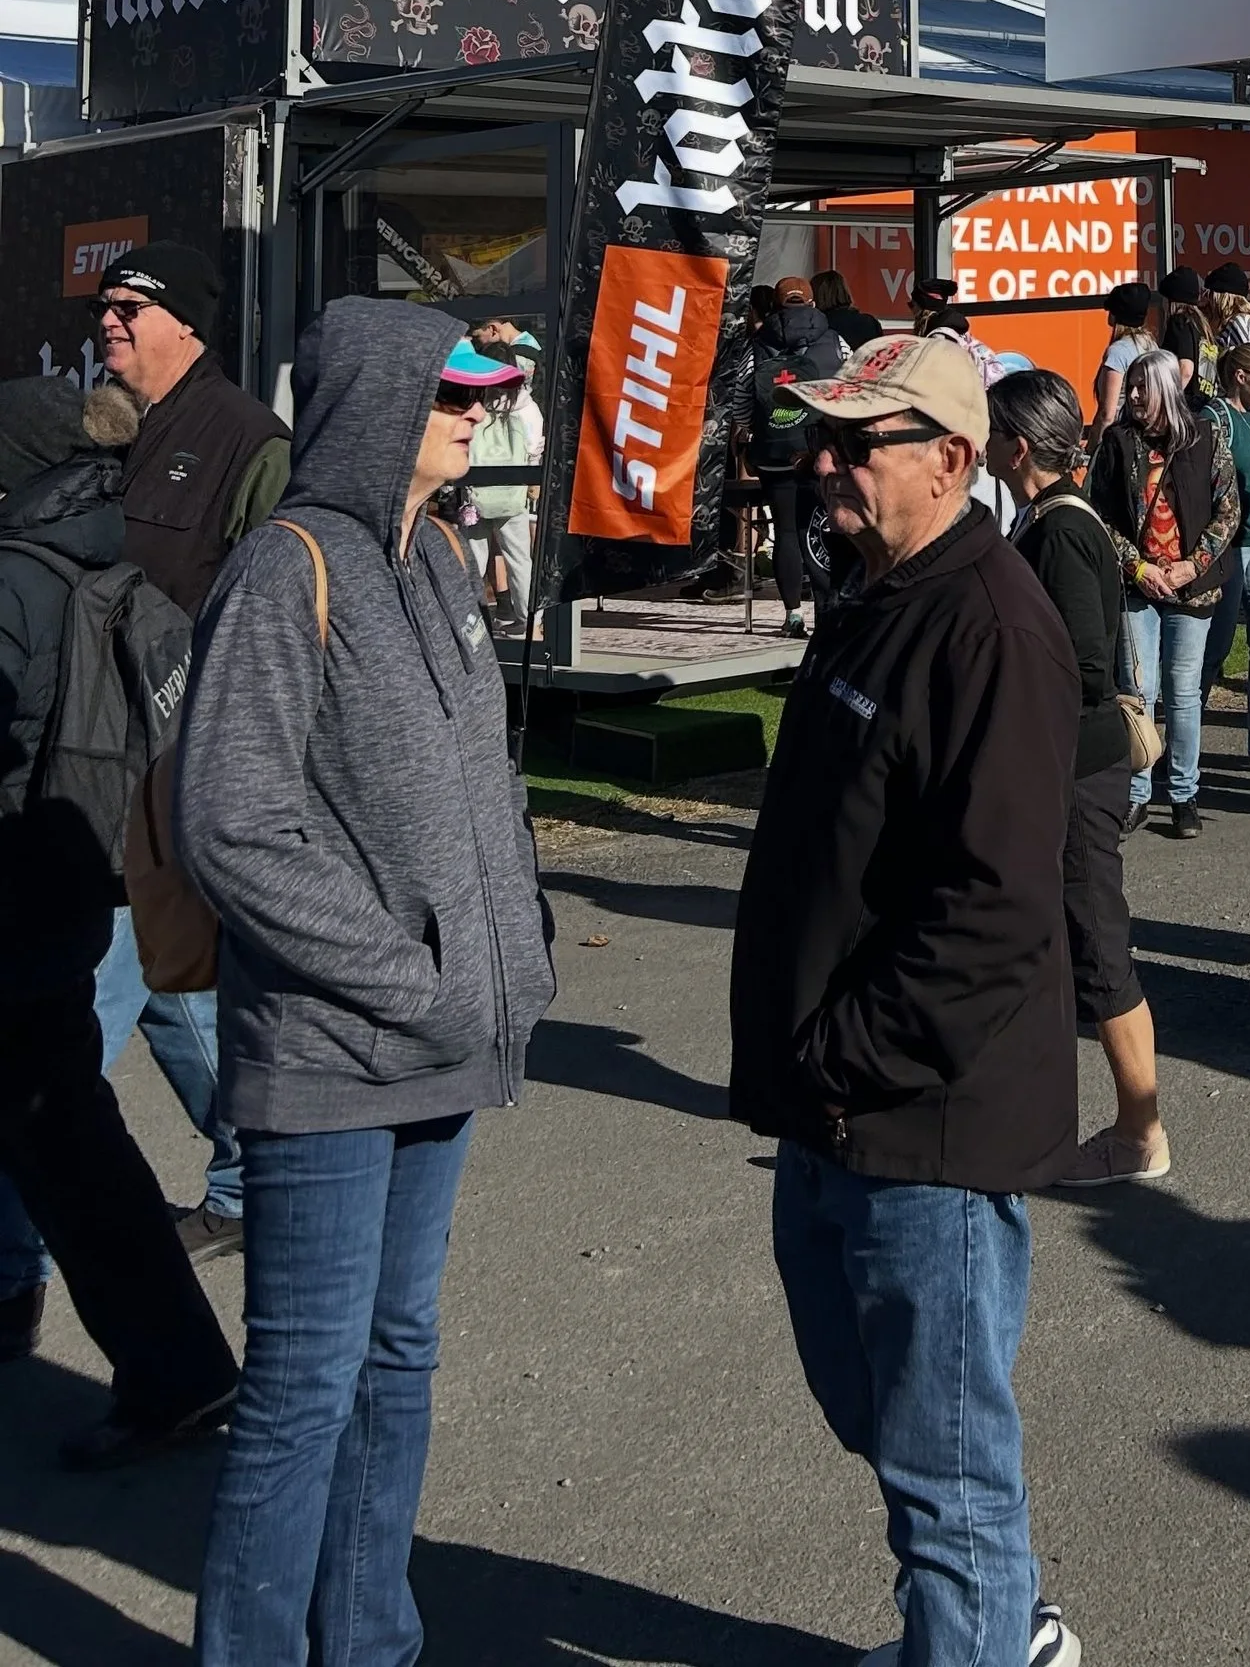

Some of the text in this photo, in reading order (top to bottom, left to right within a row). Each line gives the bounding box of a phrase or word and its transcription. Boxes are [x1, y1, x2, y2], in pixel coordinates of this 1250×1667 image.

[1110, 177, 1154, 205] YO
[951, 216, 1113, 254] ZEALAND
[73, 240, 133, 275] STIH
[988, 269, 1038, 301] OF
[613, 285, 687, 511] STIHL
